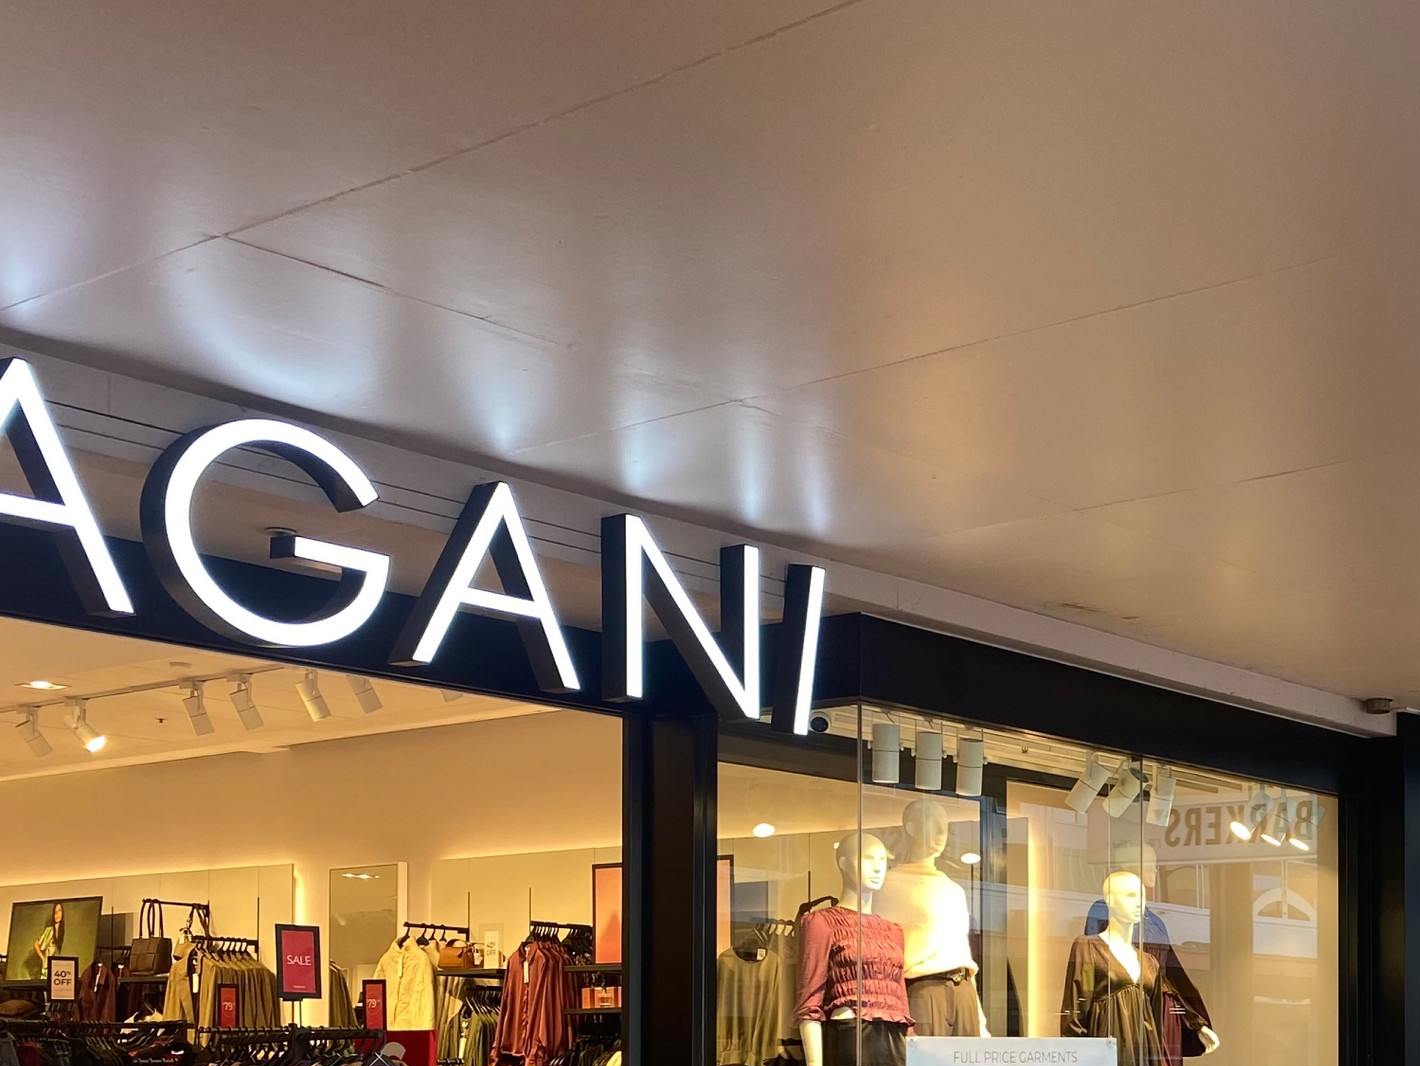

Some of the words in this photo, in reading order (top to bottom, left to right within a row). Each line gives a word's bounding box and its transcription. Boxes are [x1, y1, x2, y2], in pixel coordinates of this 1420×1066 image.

[286, 954, 312, 966] SALE
[954, 1051, 980, 1064] FULL
[984, 1051, 1016, 1064] PRICE
[1019, 1050, 1078, 1064] GARMENTS
